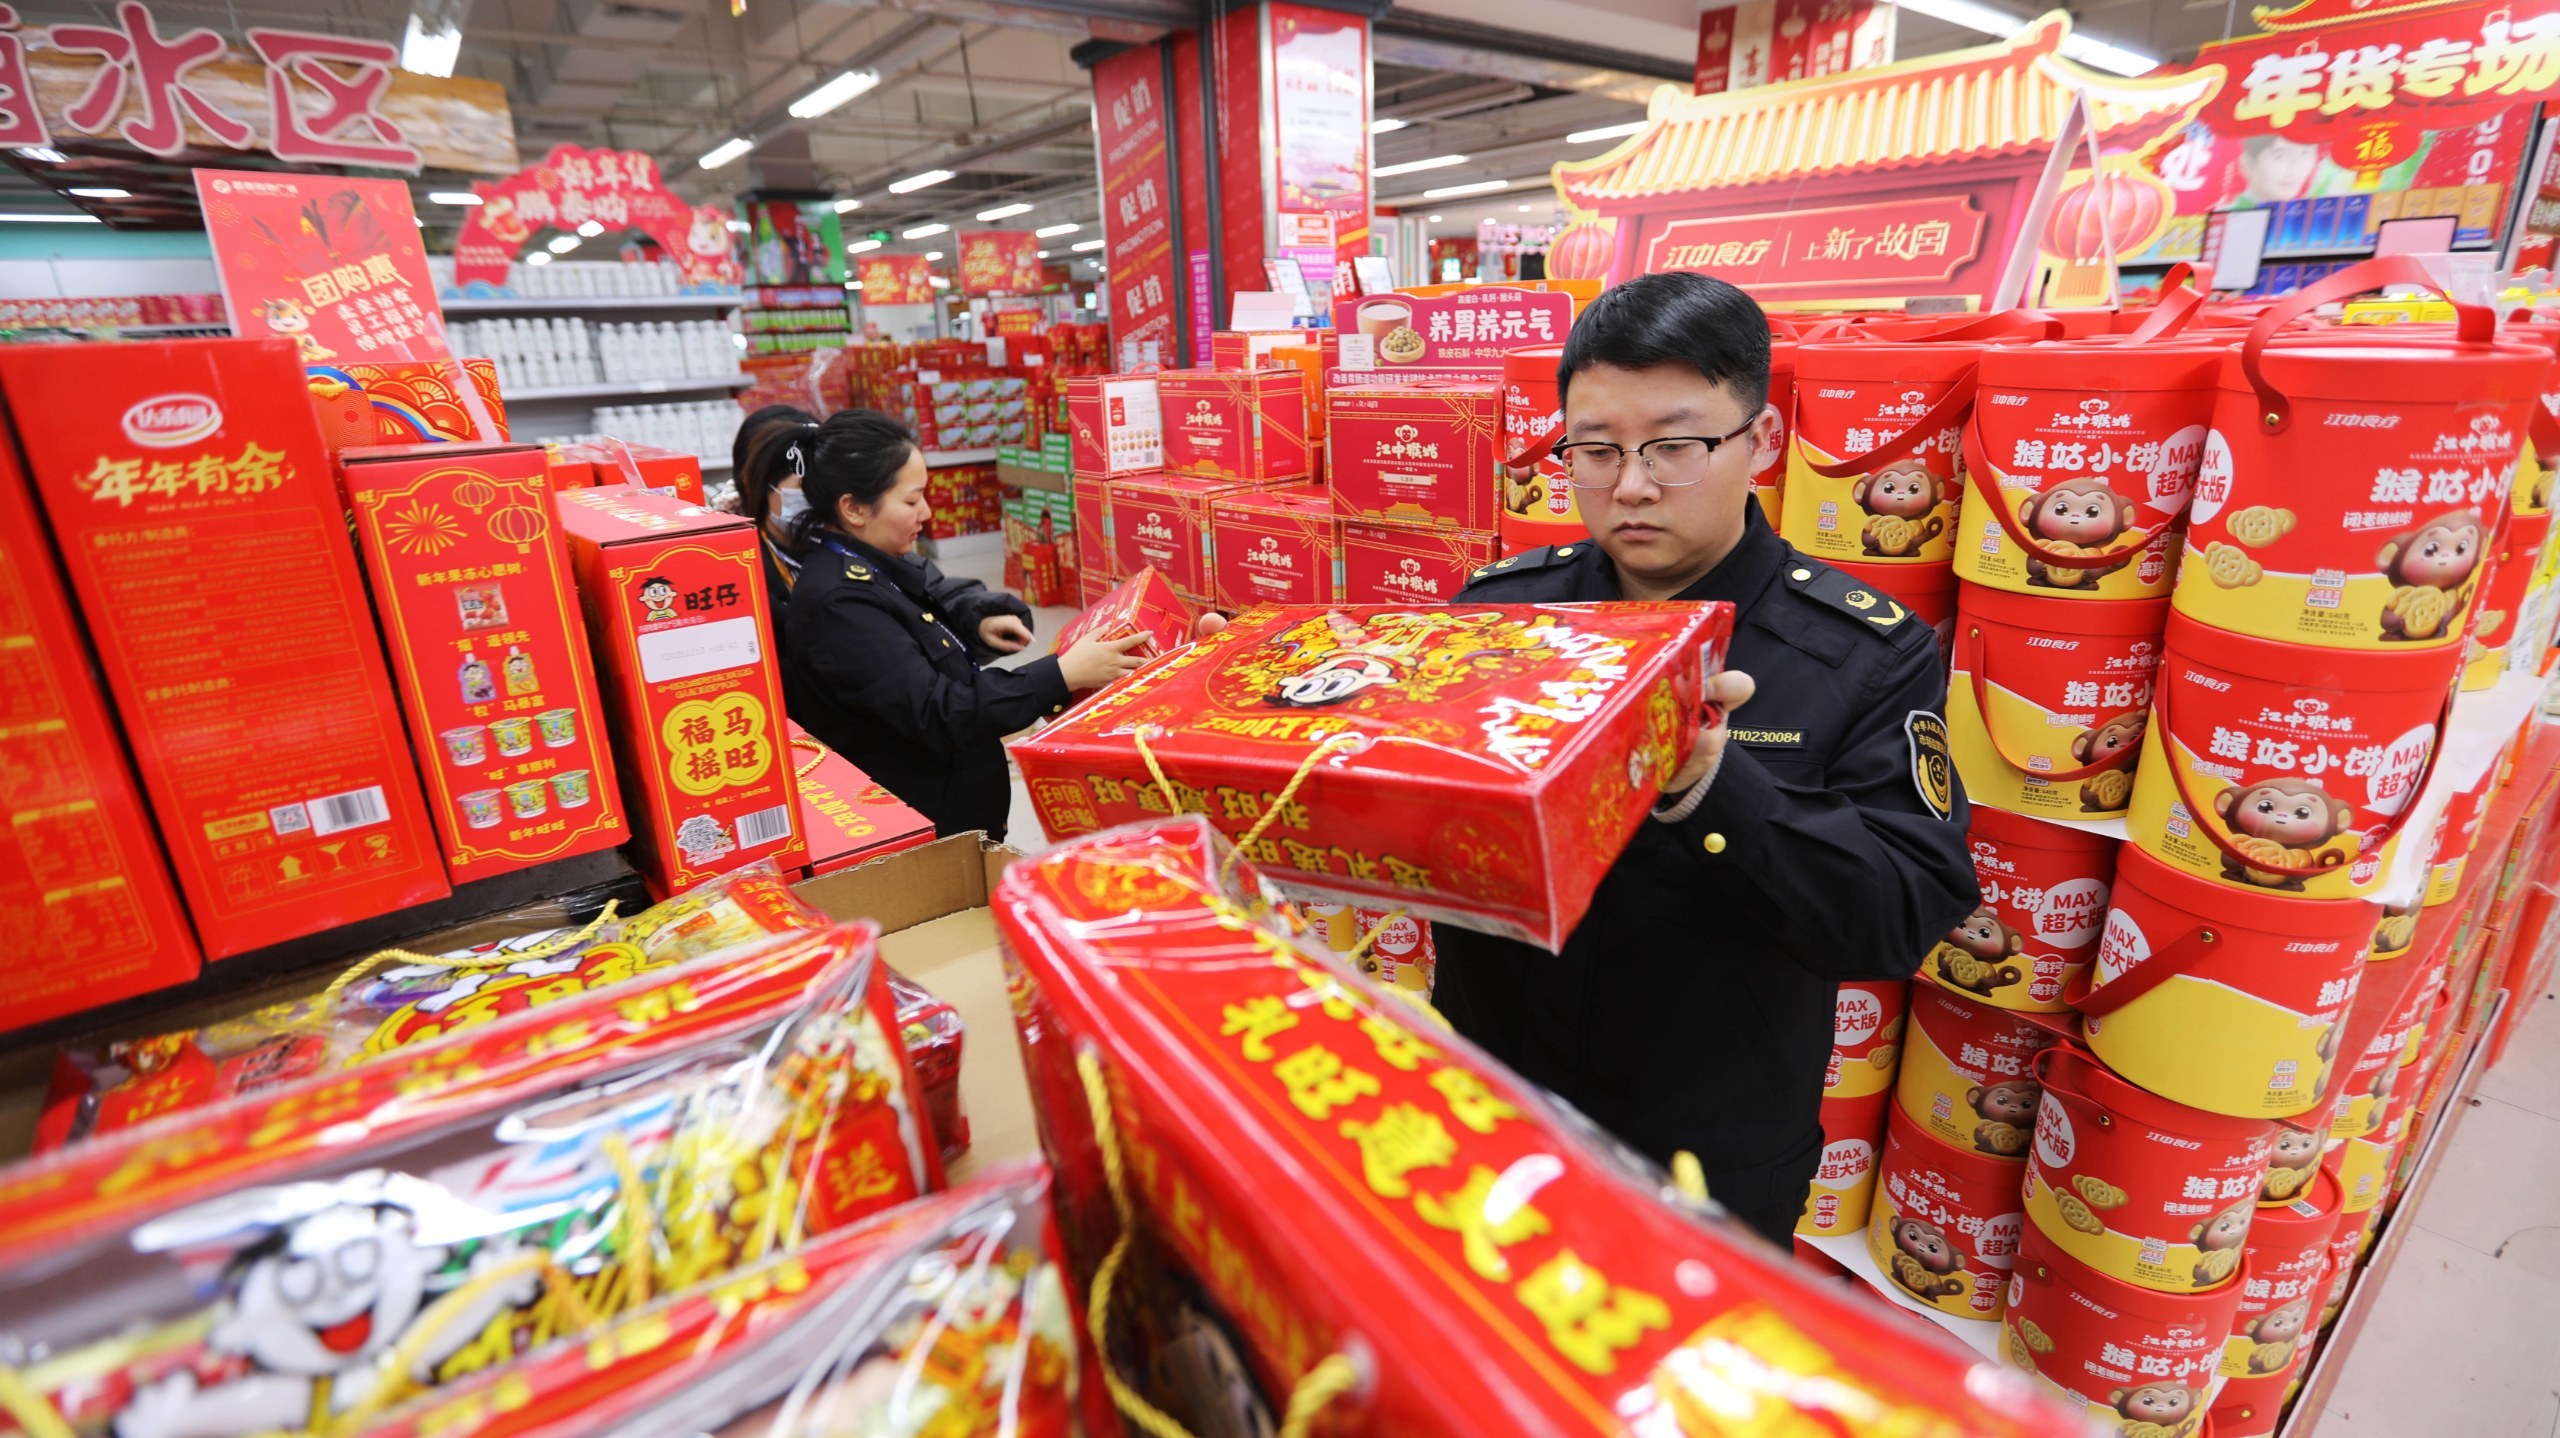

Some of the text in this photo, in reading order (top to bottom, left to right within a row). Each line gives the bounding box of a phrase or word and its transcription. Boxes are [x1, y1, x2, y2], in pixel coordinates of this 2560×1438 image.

[2234, 13, 2560, 128] 年货专场
[1112, 77, 1152, 132] 促销
[2355, 131, 2394, 162] 福
[1119, 178, 1158, 227] 促销
[1116, 218, 1164, 257] PROMOTION
[1662, 219, 1948, 269] 江中食疗 上新了故宫
[301, 254, 413, 307] 团购惠
[1126, 274, 1164, 318] 促销
[1429, 307, 1553, 342] 养胃养元气
[1878, 403, 1934, 417] 江中猴
[1991, 394, 2029, 406] 江中食疗
[2324, 413, 2401, 428] 江中食疗
[2012, 438, 2160, 474] 猴姑小饼
[88, 442, 286, 507] 年年有余
[684, 583, 740, 611] 旺仔
[2027, 636, 2080, 650] 江中食疗
[2183, 670, 2232, 692] 江中食疗
[2209, 726, 2384, 777] 猴姑小饼
[509, 820, 566, 842] 新年旺旺
[2053, 890, 2098, 910] MAX
[2042, 907, 2106, 933] 超大版
[1381, 931, 1417, 944] 超大版
[2109, 920, 2136, 953] MAX
[2285, 942, 2340, 953] 江中食疗
[2033, 961, 2065, 975] 高钙
[2029, 982, 2060, 997] 高锌
[2146, 1131, 2202, 1151] 江中食疗
[1827, 1147, 1861, 1163] MAX
[1819, 1158, 1869, 1180] 超大版
[1815, 1197, 1840, 1210] 高钙
[1889, 1172, 1985, 1236] 猴姑小饼
[1813, 1214, 1838, 1226] 高锌
[1974, 1277, 2001, 1291] 高钙
[1969, 1295, 1997, 1309] 高锌
